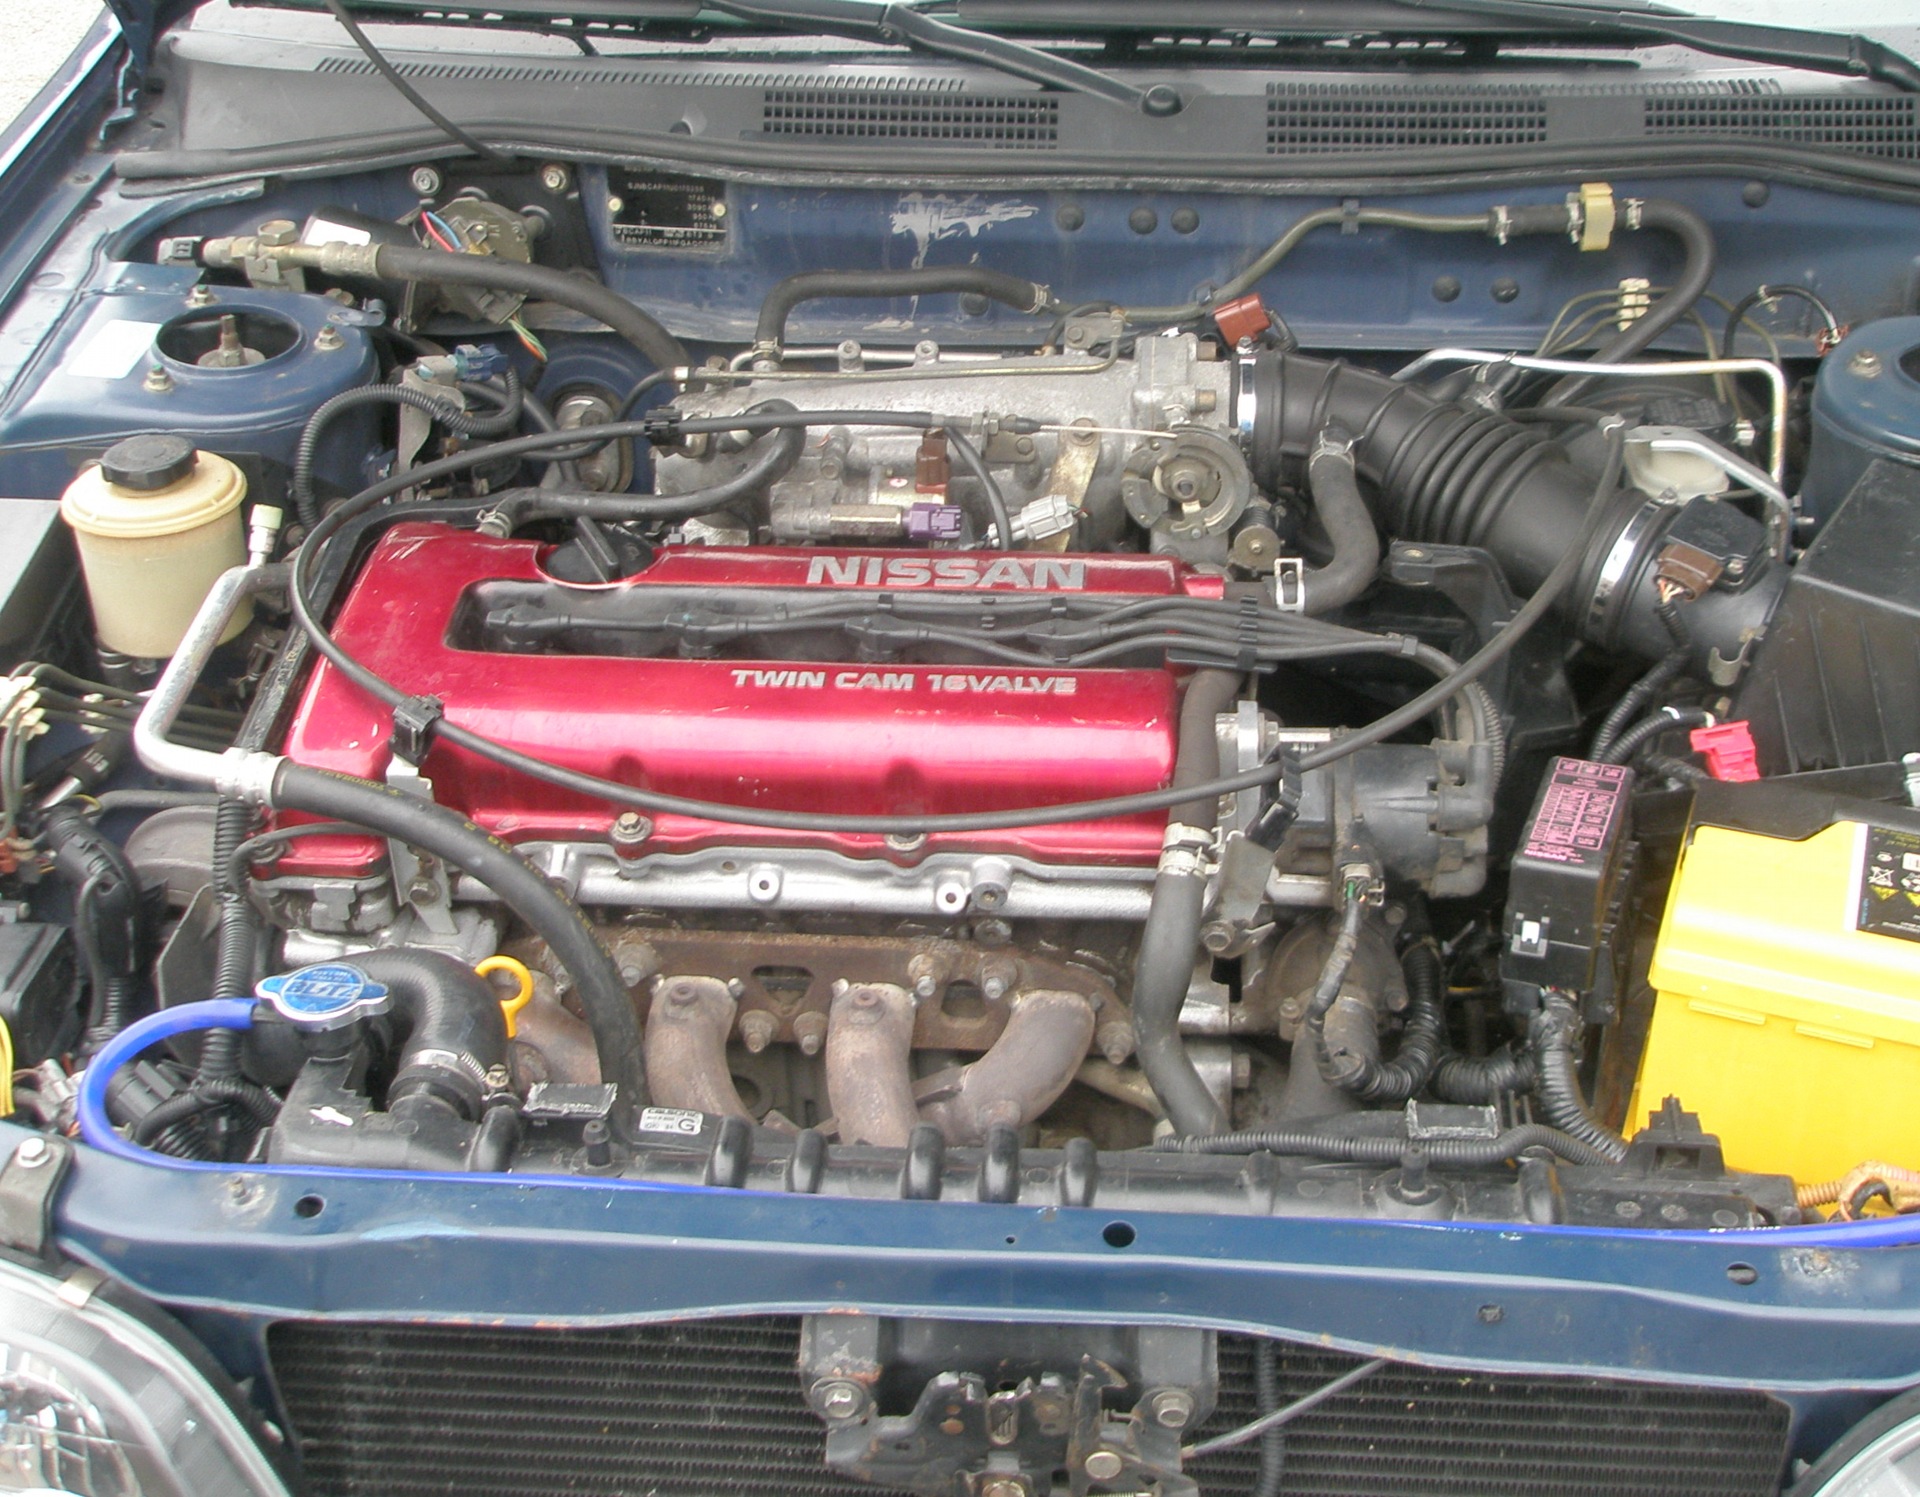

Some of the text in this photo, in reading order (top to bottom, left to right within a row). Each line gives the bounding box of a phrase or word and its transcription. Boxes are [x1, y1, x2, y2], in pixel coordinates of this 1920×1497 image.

[806, 555, 1086, 589] NISSAN
[731, 669, 1077, 693] TWIN CAM 16VALVE
[677, 1118, 695, 1131] G
